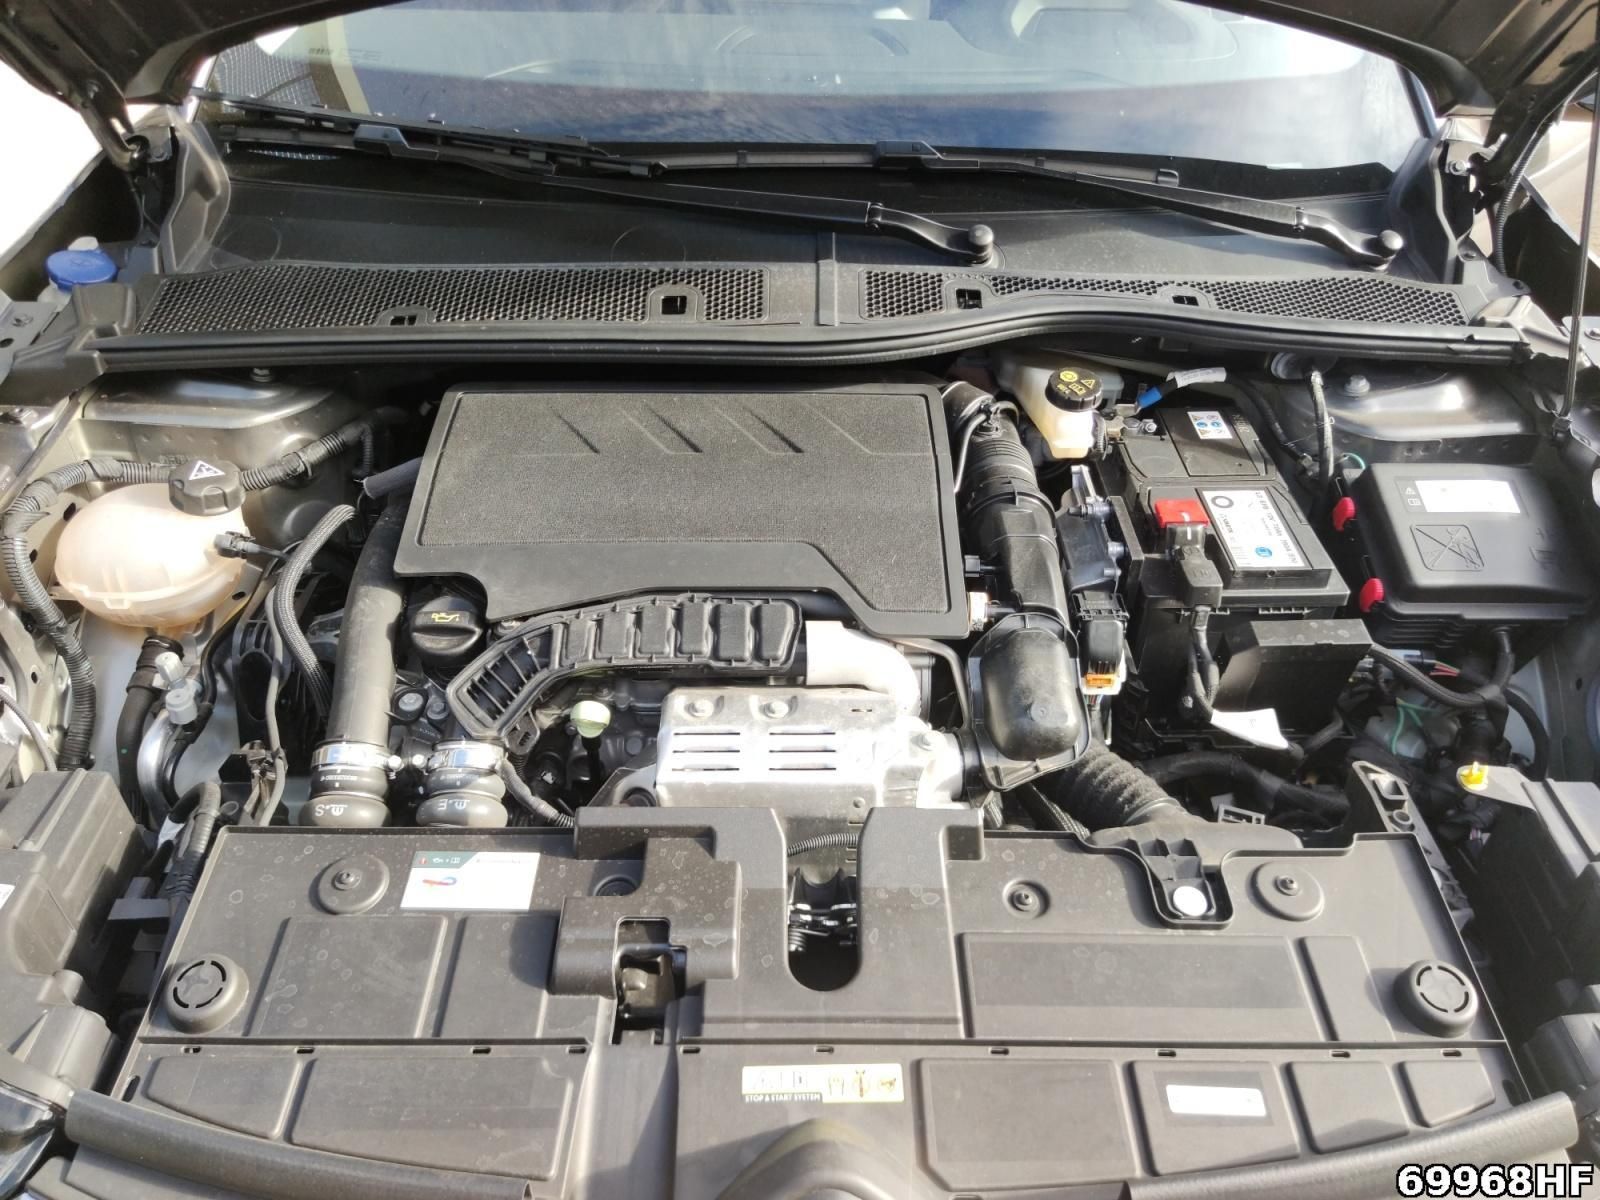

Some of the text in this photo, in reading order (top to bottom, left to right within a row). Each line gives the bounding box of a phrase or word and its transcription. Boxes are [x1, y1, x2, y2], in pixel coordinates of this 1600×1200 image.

[745, 1094, 764, 1103] STOP
[771, 1094, 792, 1102] START
[794, 1093, 820, 1102] SYSTEM
